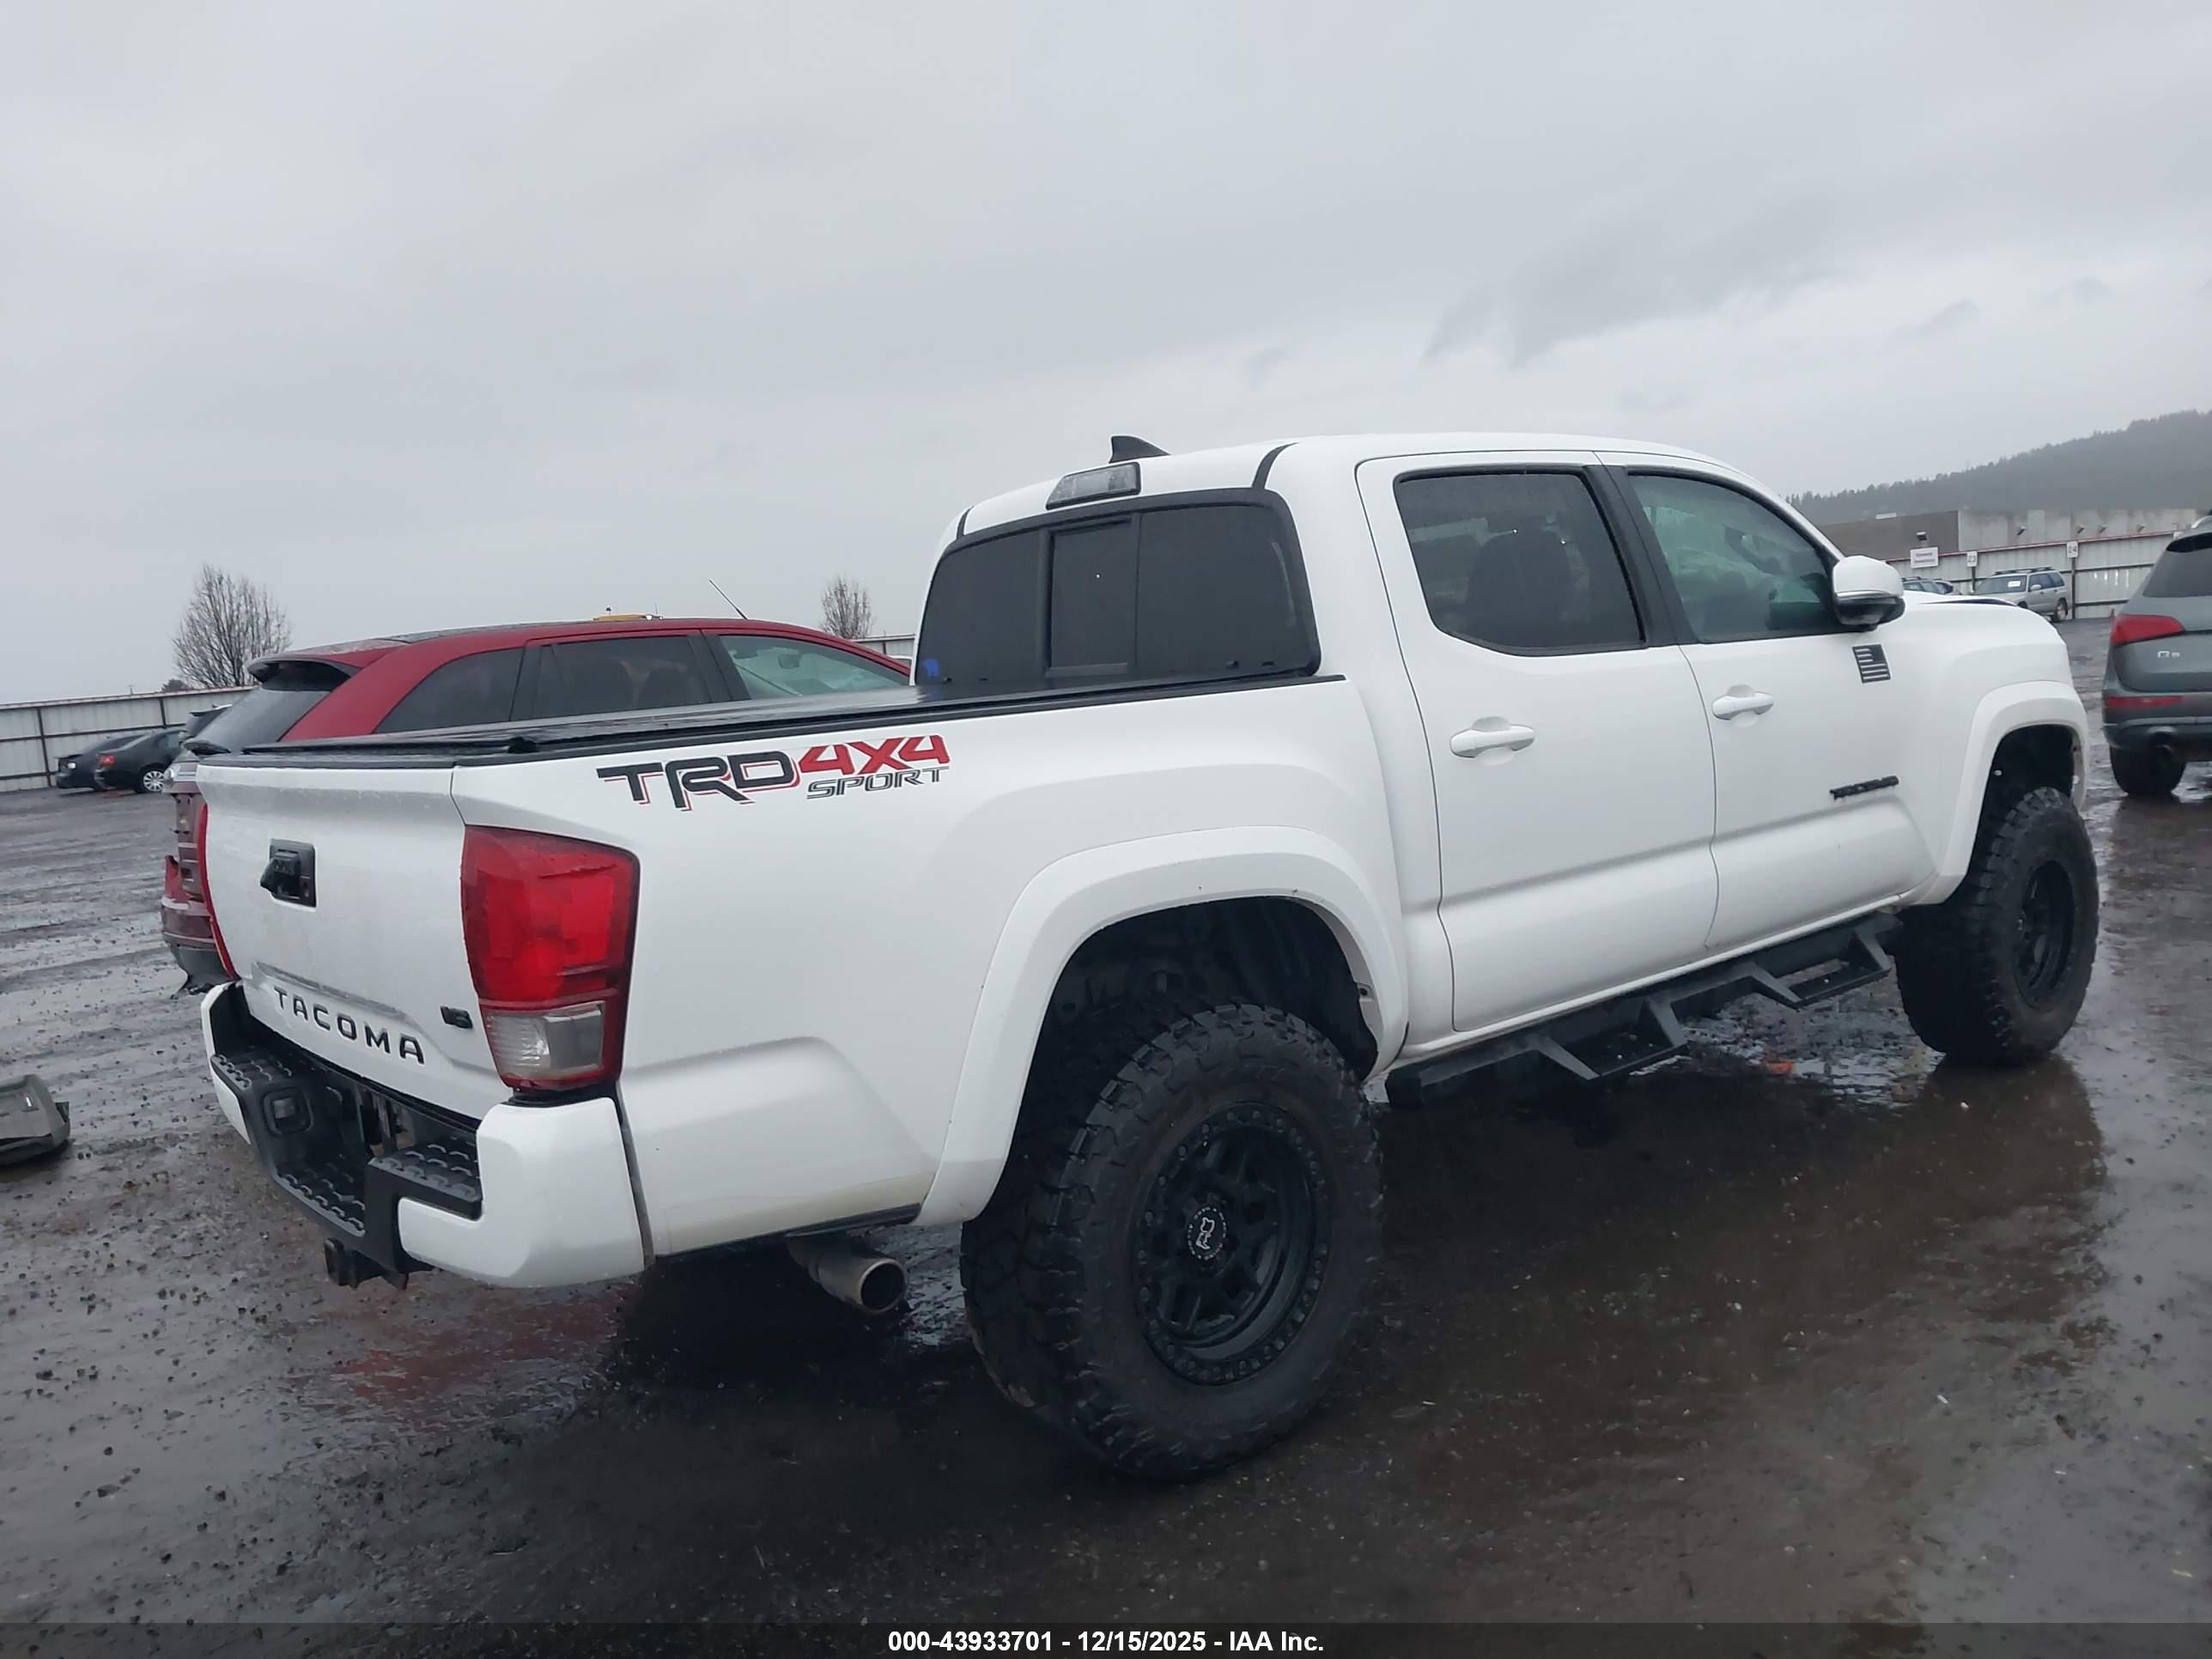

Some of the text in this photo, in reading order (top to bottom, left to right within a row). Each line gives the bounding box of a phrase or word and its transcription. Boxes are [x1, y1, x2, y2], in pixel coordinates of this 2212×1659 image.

[596, 751, 800, 811] TRD
[806, 766, 951, 800] SPORT
[273, 987, 425, 1066] TACOMA
